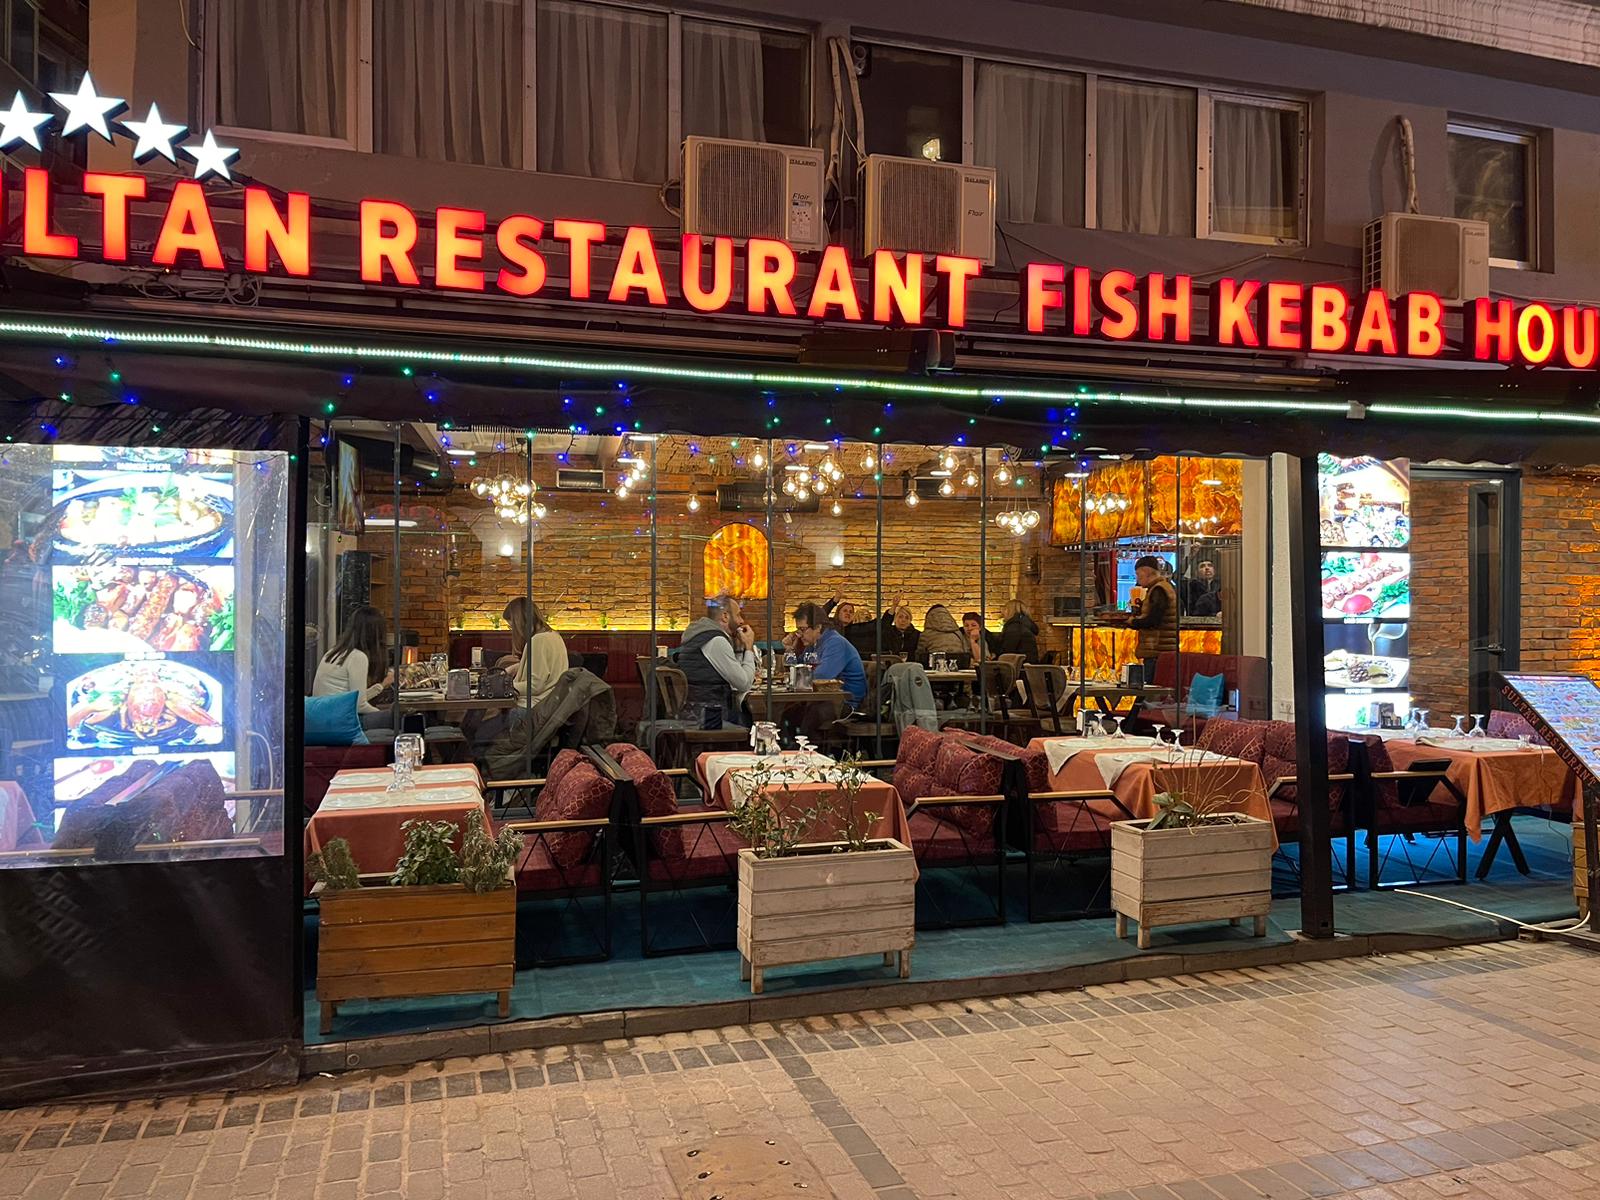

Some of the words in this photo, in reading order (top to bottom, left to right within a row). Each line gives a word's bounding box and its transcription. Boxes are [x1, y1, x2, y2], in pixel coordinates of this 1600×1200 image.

[0, 167, 311, 277] LTAN
[359, 199, 982, 328] RESTAURANT
[1027, 263, 1193, 342] FISH
[1218, 278, 1446, 357] KEBAB
[1475, 297, 1599, 368] HOU
[1502, 685, 1539, 726] SULTAN
[1539, 725, 1597, 786] RESTURANT
